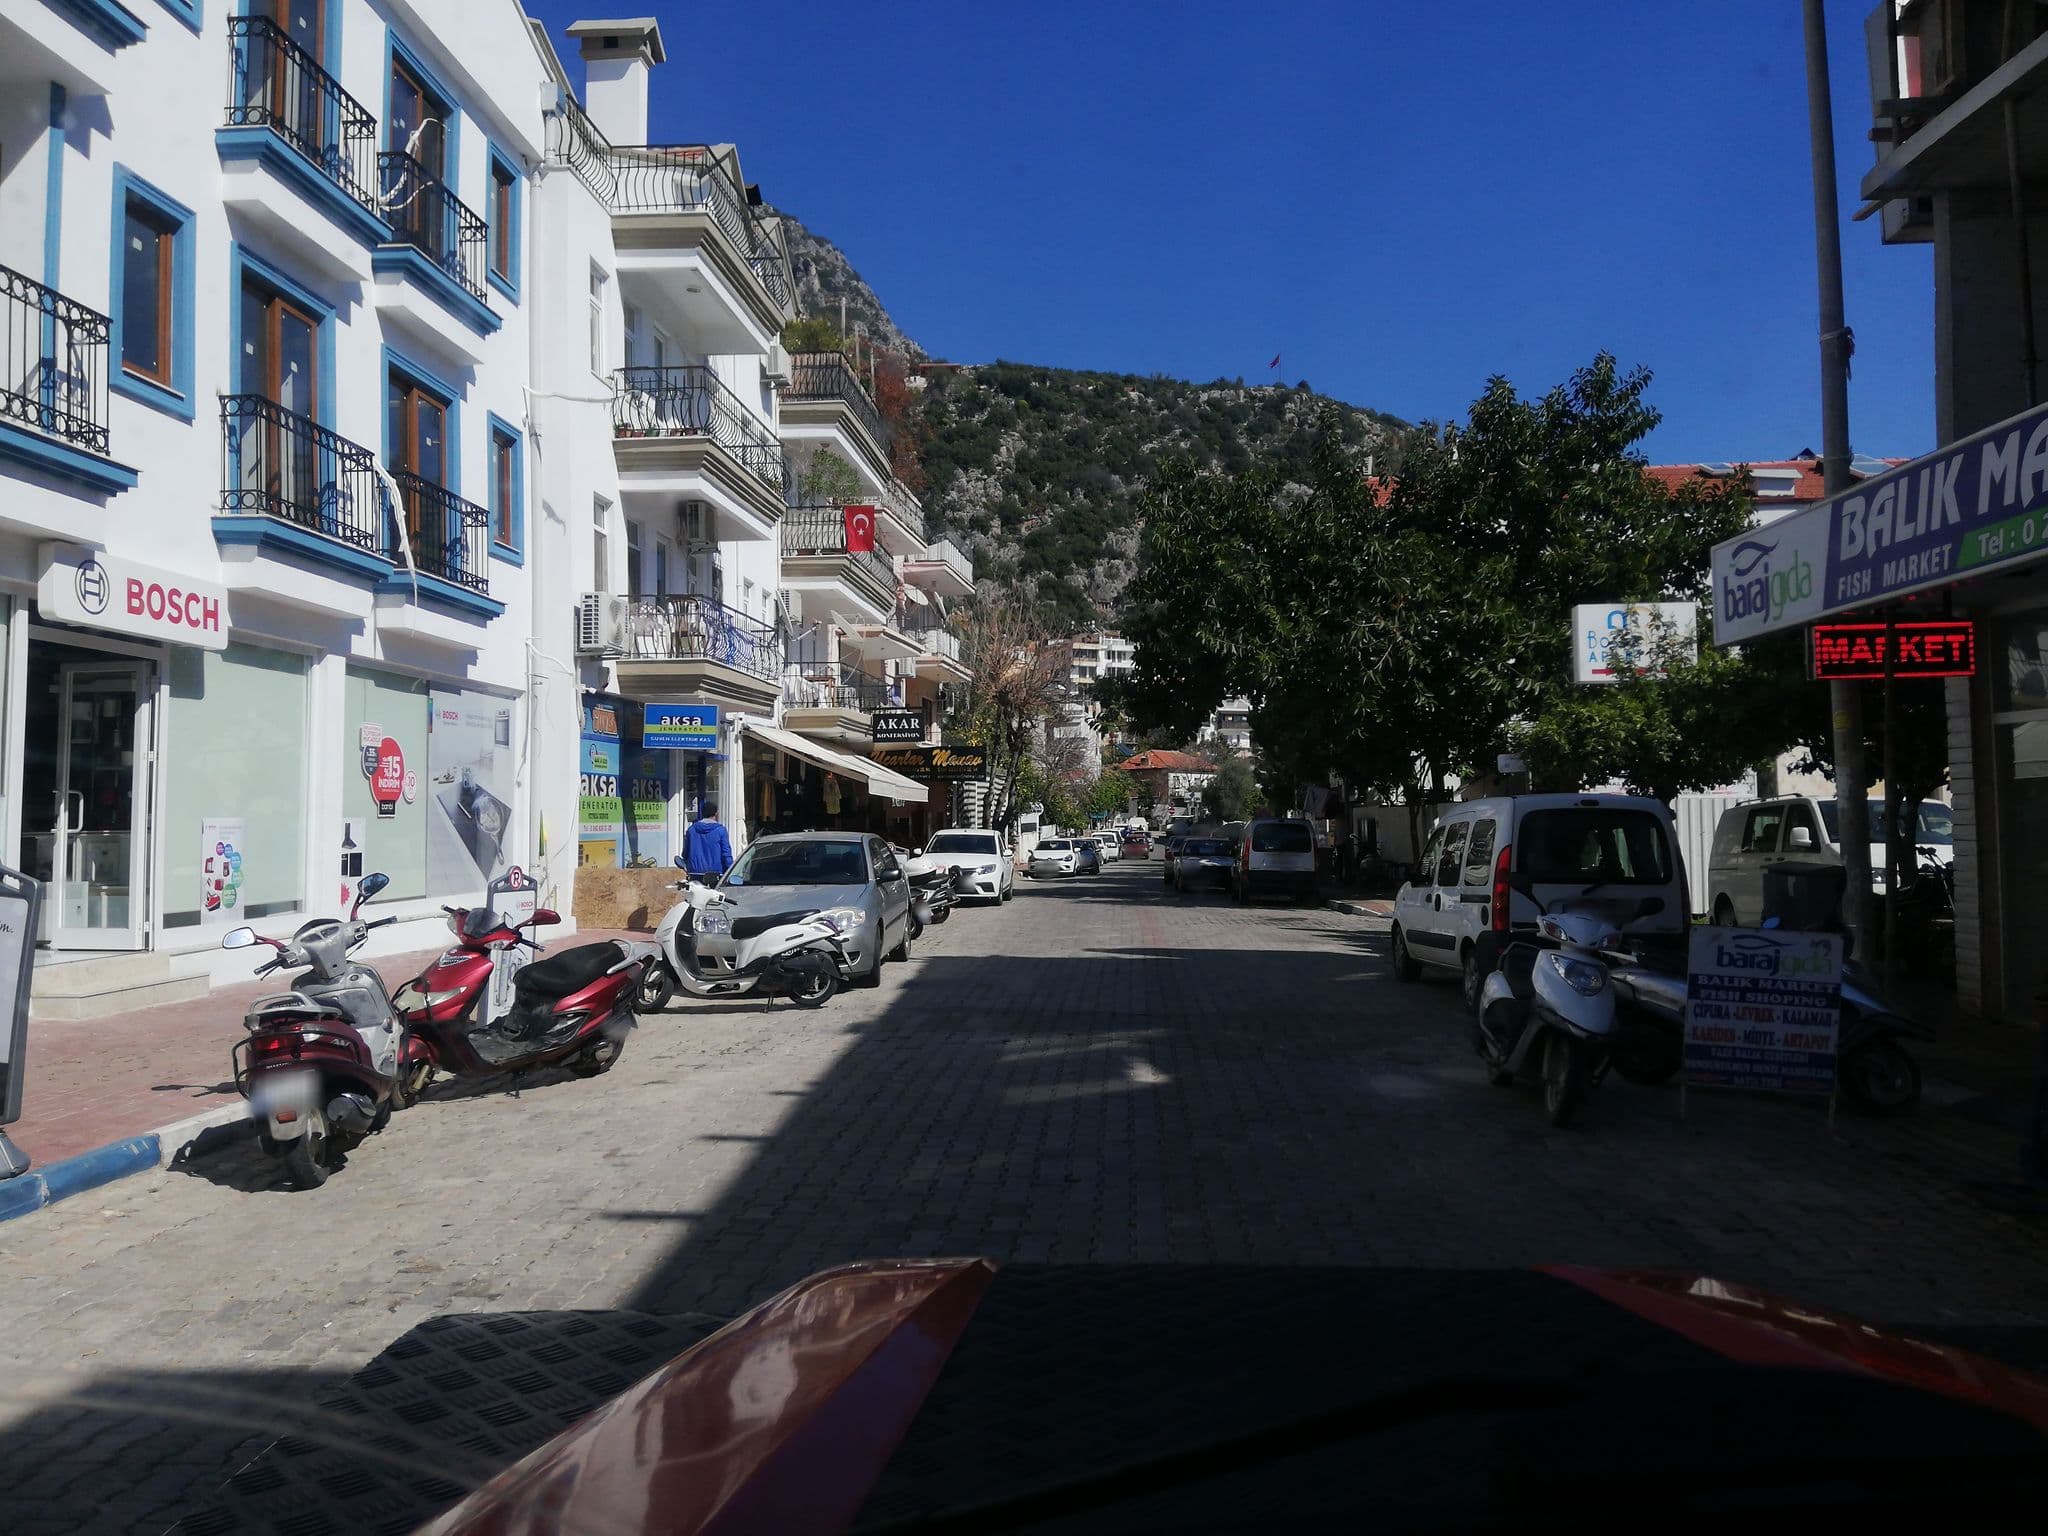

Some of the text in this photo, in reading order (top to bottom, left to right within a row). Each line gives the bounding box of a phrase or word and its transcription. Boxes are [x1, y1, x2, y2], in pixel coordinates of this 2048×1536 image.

[1840, 453, 1965, 562] BALIK
[1978, 526, 2004, 559] Tel
[1838, 543, 1953, 600] FISH MARKET
[126, 578, 219, 632] BOSCH
[661, 716, 702, 726] aksa
[877, 718, 920, 730] AKAR
[581, 774, 616, 797] aksa
[632, 779, 662, 799] aksa
[1697, 975, 1838, 994] BALIK MARKET
[1700, 989, 1828, 1007] FISH SHOPING
